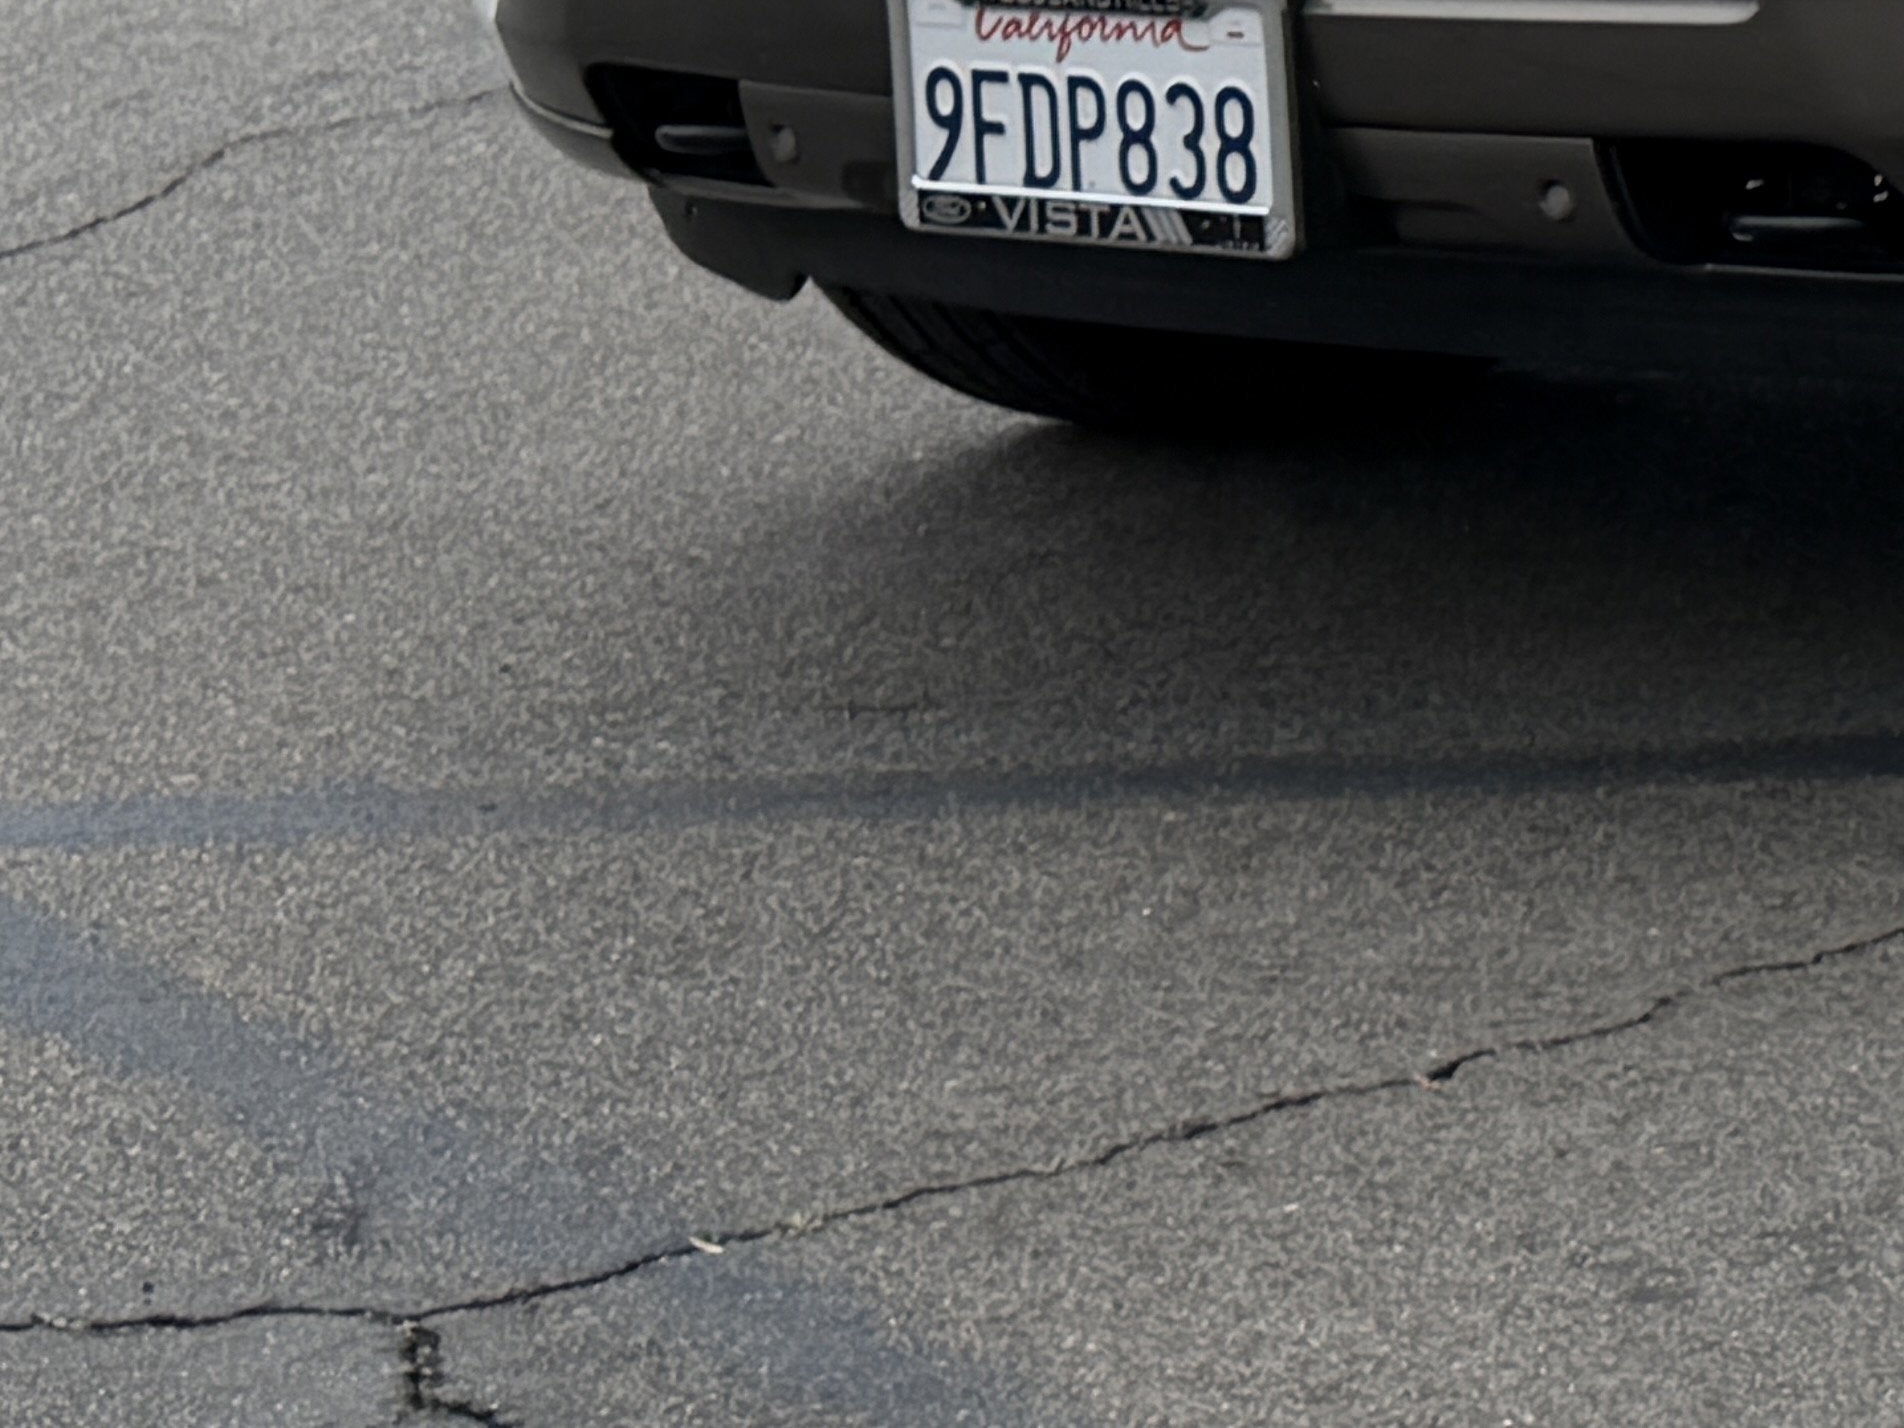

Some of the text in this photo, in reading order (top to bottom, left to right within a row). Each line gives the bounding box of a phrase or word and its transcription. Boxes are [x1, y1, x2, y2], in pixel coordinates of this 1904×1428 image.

[973, 8, 1210, 63] California
[923, 65, 1258, 205] 9FDP838
[992, 195, 1148, 242] VISTA
